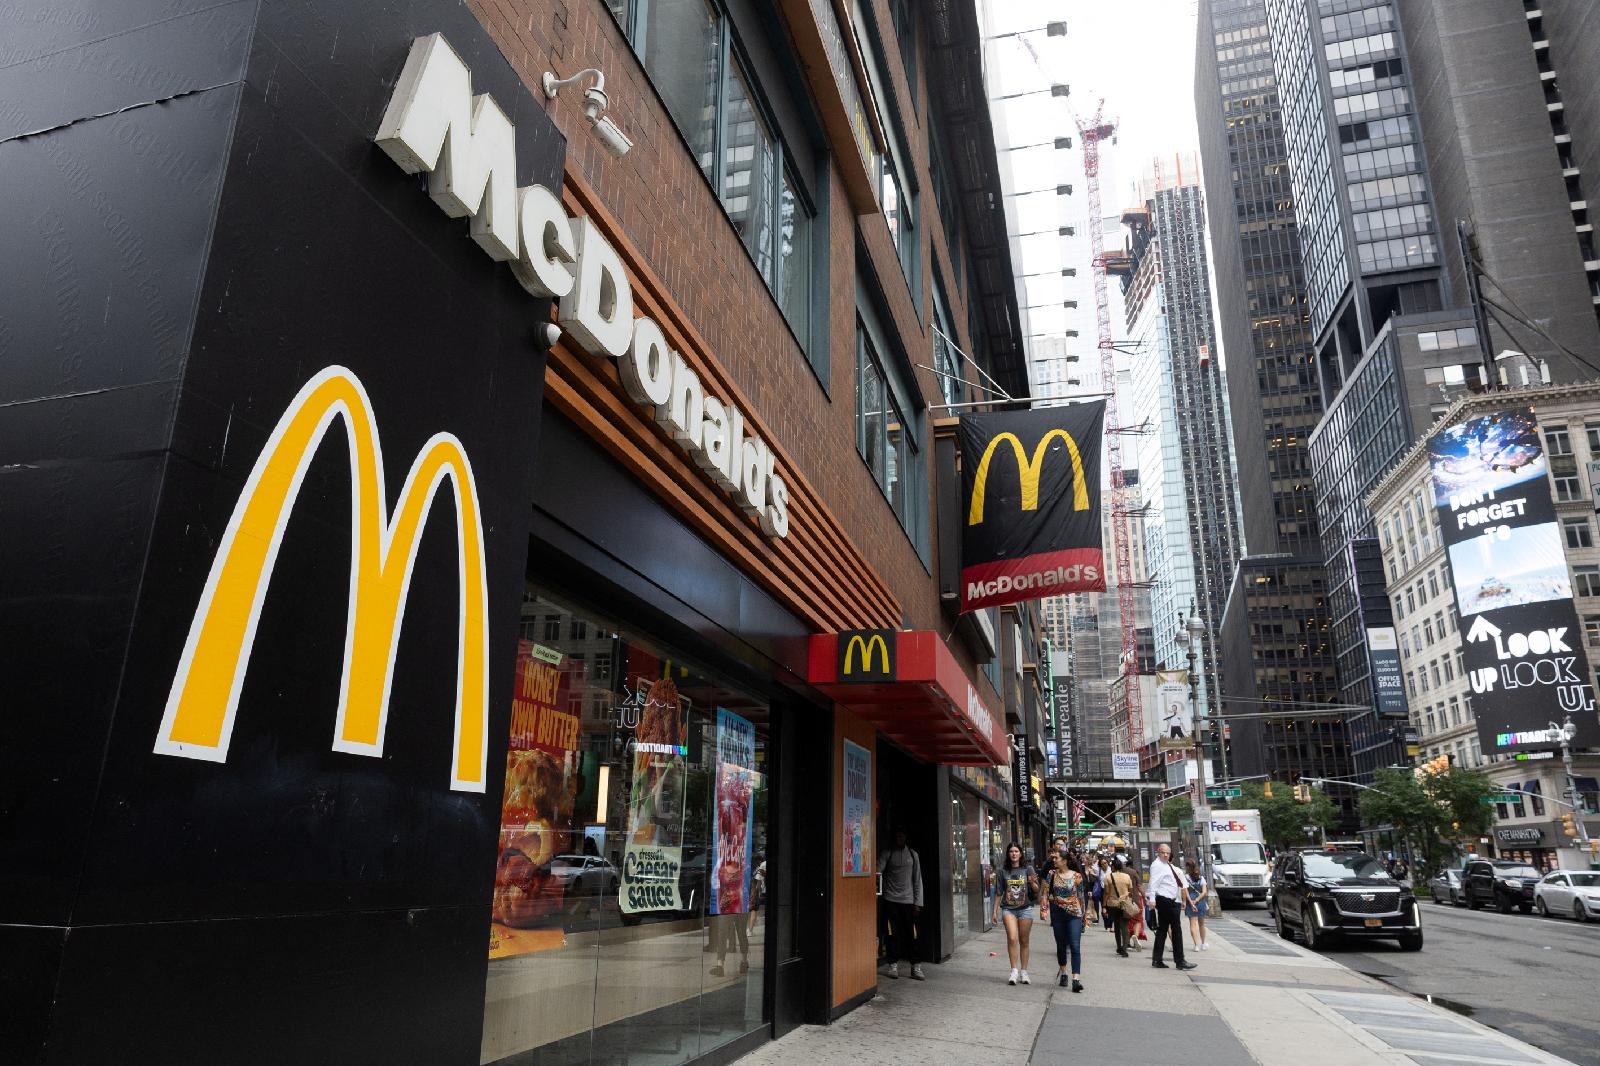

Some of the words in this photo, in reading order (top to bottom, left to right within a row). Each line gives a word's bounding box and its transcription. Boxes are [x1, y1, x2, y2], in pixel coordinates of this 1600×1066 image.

[375, 31, 789, 539] McDonald's
[1457, 498, 1527, 530] FORGET
[1484, 525, 1511, 544] TO
[967, 563, 1099, 601] McDonald's
[1495, 627, 1572, 660] LOOK
[1470, 667, 1498, 694] UP
[1501, 657, 1581, 690] LOOK
[537, 706, 578, 752] BUTTER
[1018, 738, 1026, 757] TIMES
[1019, 757, 1027, 784] SQUARE
[1211, 821, 1247, 832] FedEx
[624, 852, 678, 884] Caesar
[628, 886, 674, 910] sauce
